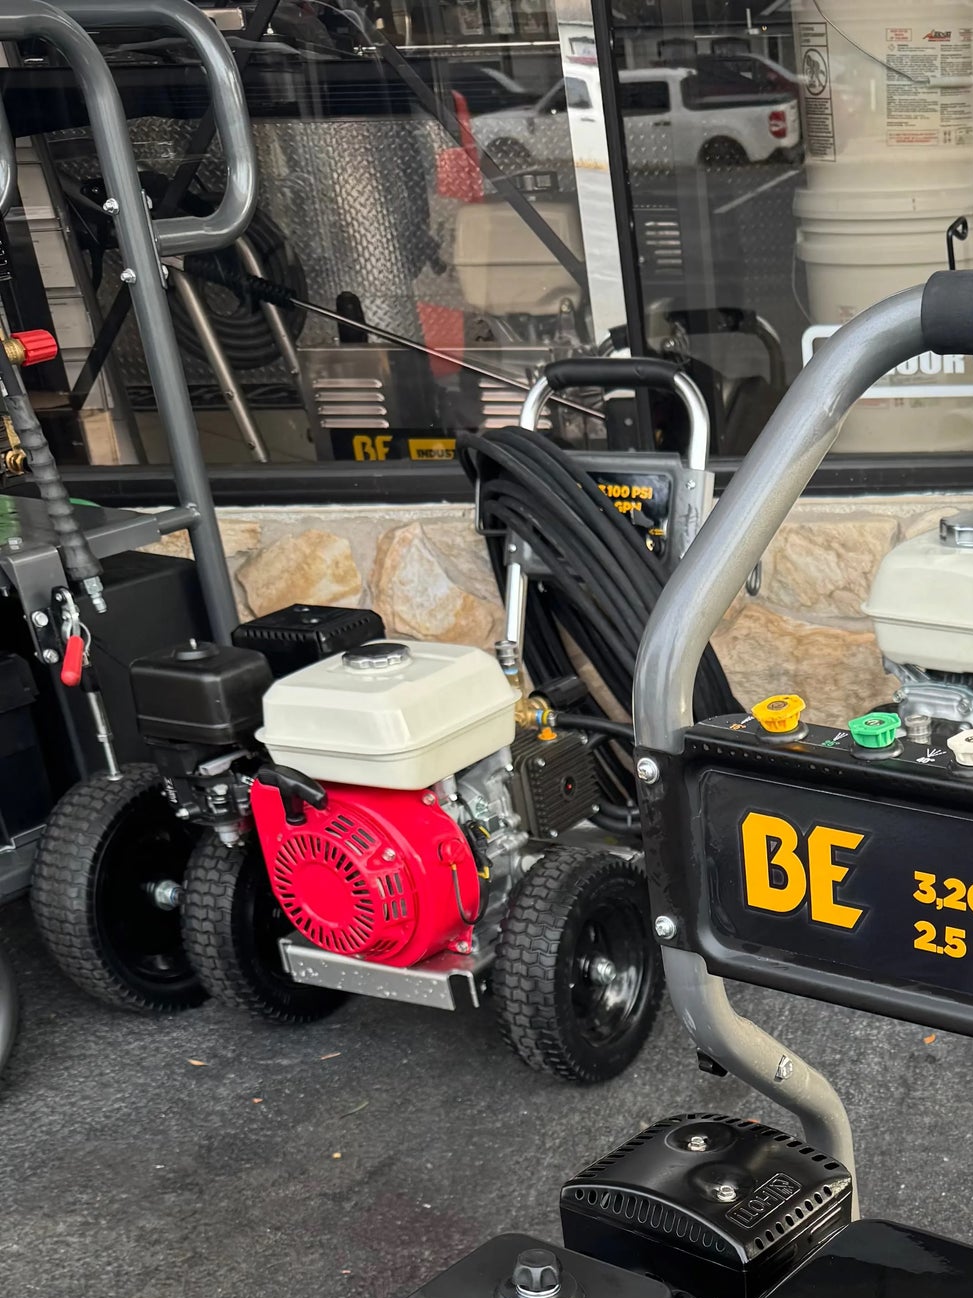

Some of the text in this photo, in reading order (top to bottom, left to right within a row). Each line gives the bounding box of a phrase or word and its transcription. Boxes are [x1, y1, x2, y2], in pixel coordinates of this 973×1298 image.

[631, 486, 653, 500] PSI
[740, 811, 870, 930] BE
[912, 919, 967, 959] 2.5
